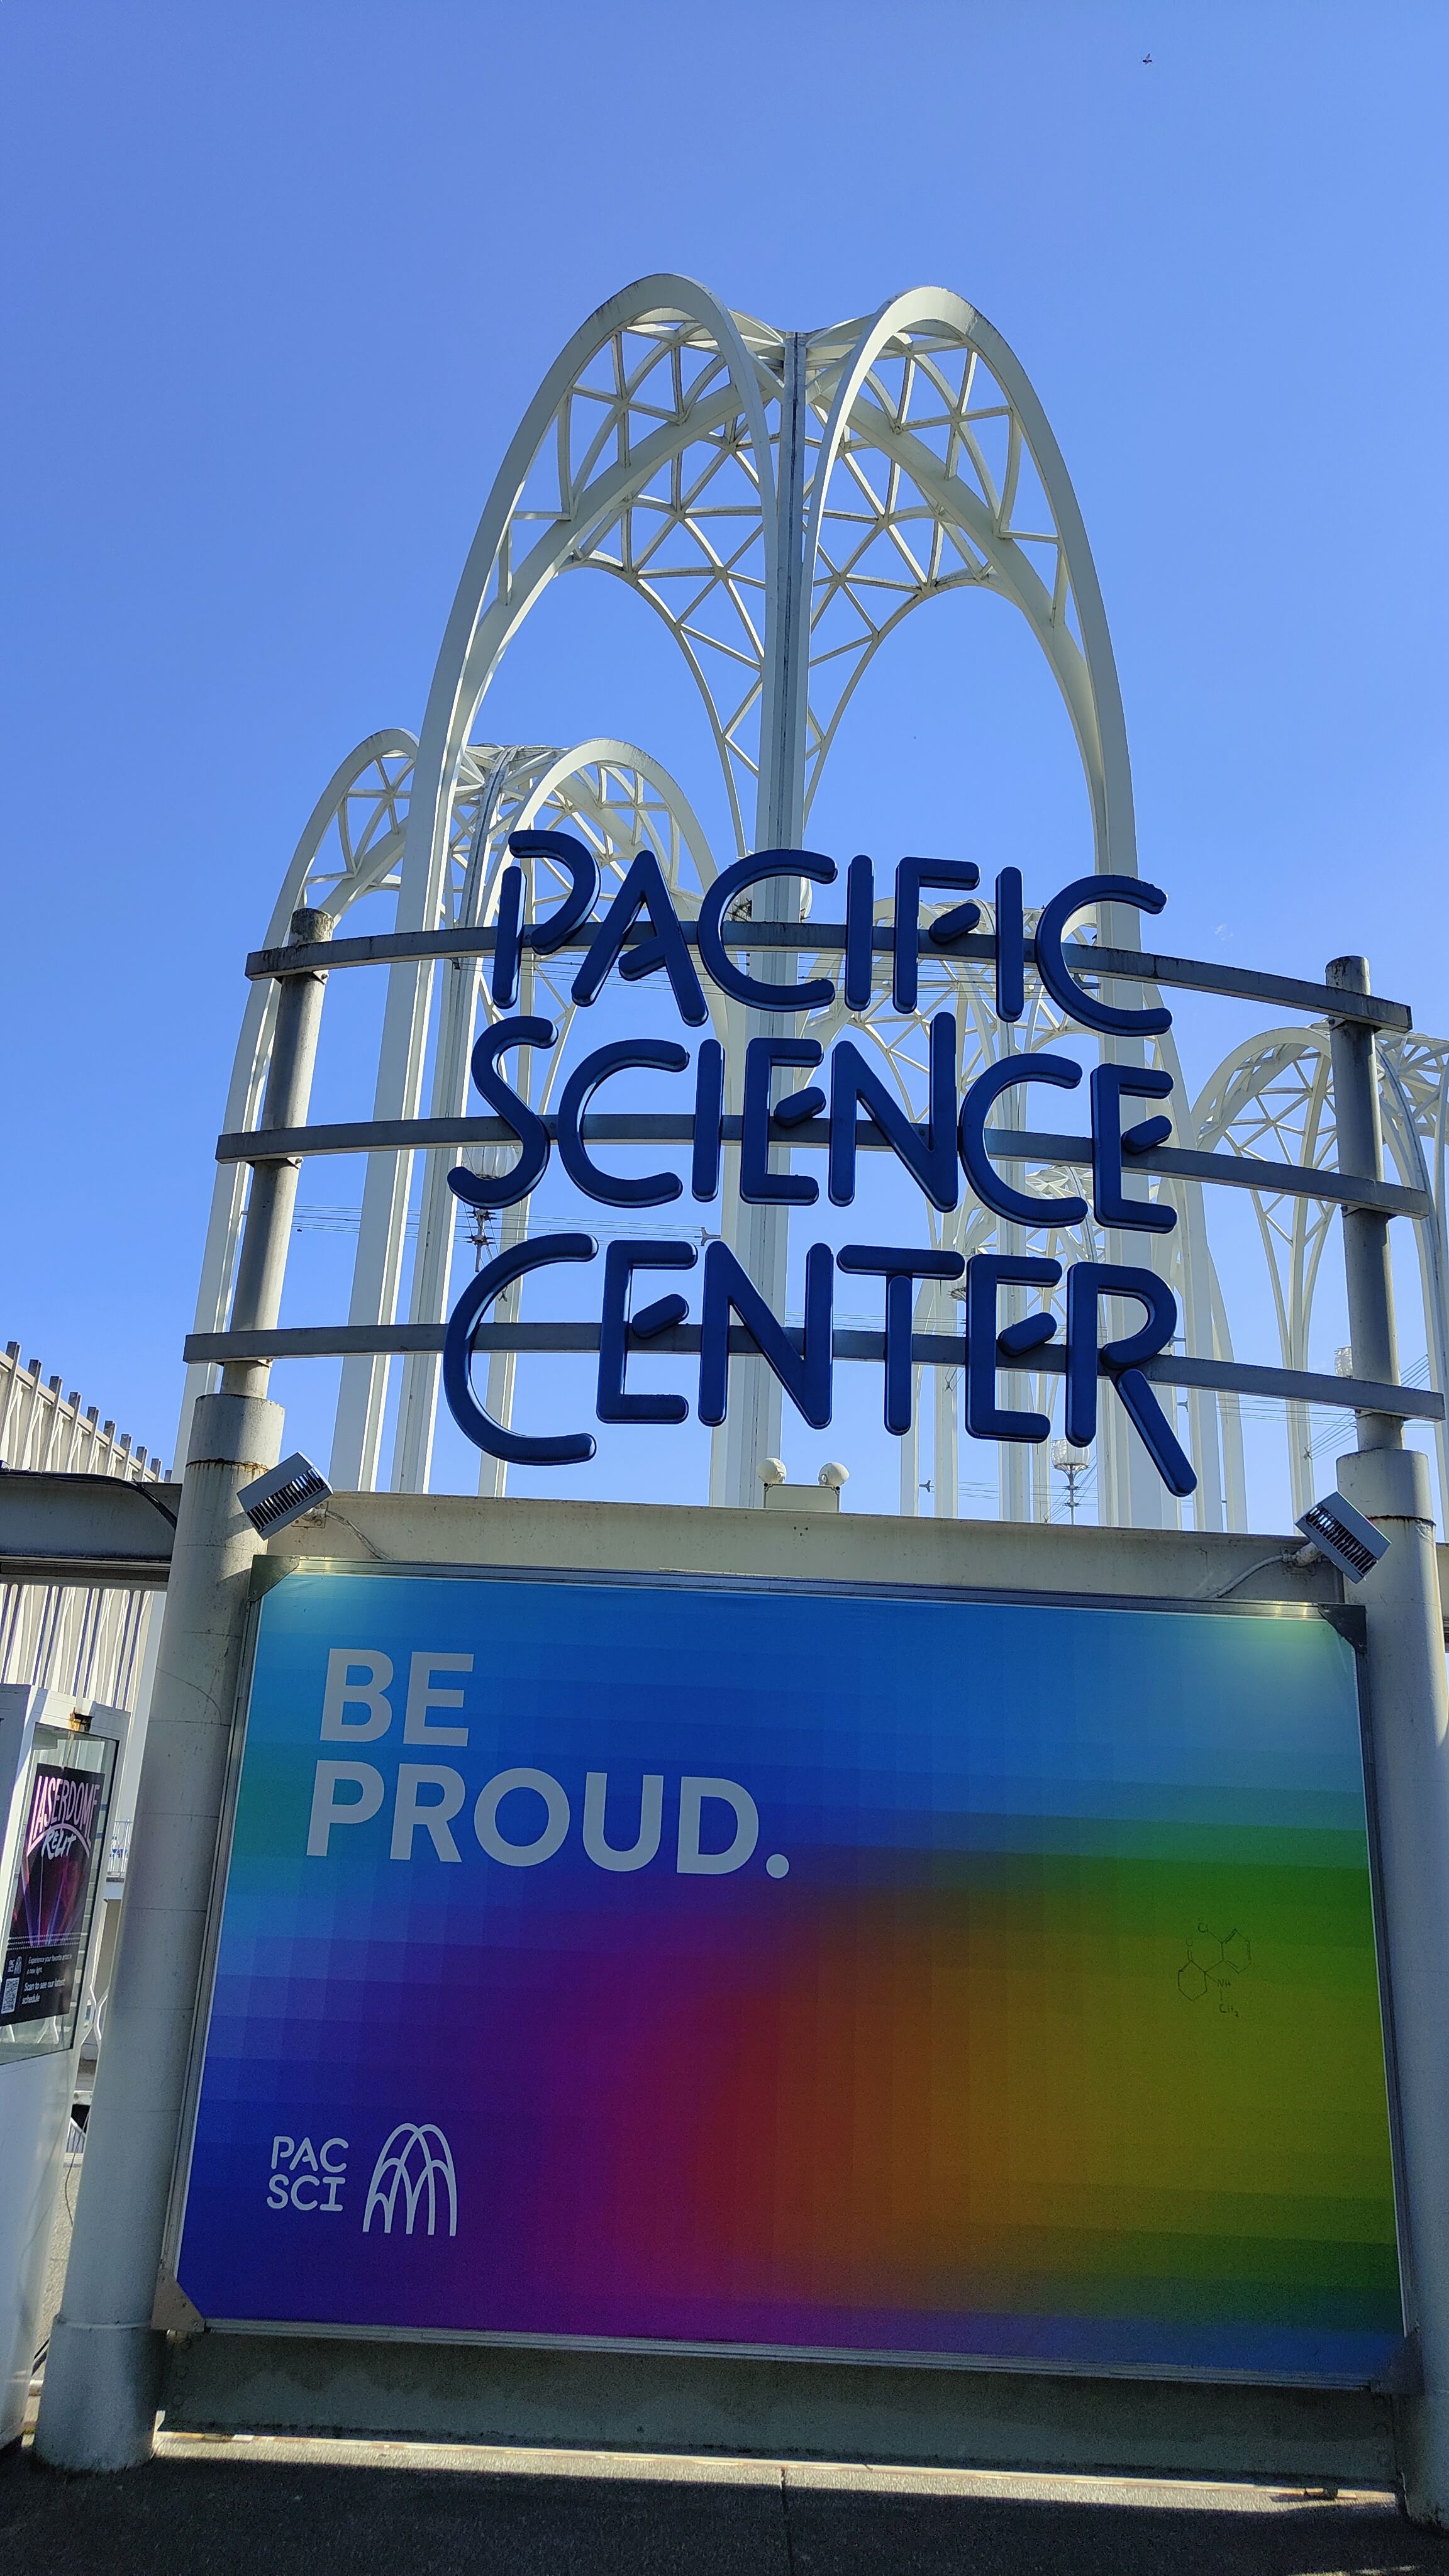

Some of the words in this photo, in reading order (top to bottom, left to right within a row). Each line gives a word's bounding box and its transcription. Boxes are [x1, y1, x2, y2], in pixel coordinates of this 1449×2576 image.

[492, 830, 1172, 1036] PACIFIC
[447, 1011, 1177, 1233] SCIENCE
[443, 1232, 1197, 1497] CENTER
[319, 1648, 474, 1746] BE
[26, 1775, 100, 1858] LASERDOME
[306, 1760, 789, 1879] PROUD.
[21, 1993, 40, 2005] schedule
[24, 1982, 35, 1992] Scan
[35, 1982, 40, 1990] to
[55, 1978, 65, 1987] latest
[267, 2174, 346, 2211] SCI
[271, 2136, 348, 2173] PAC
